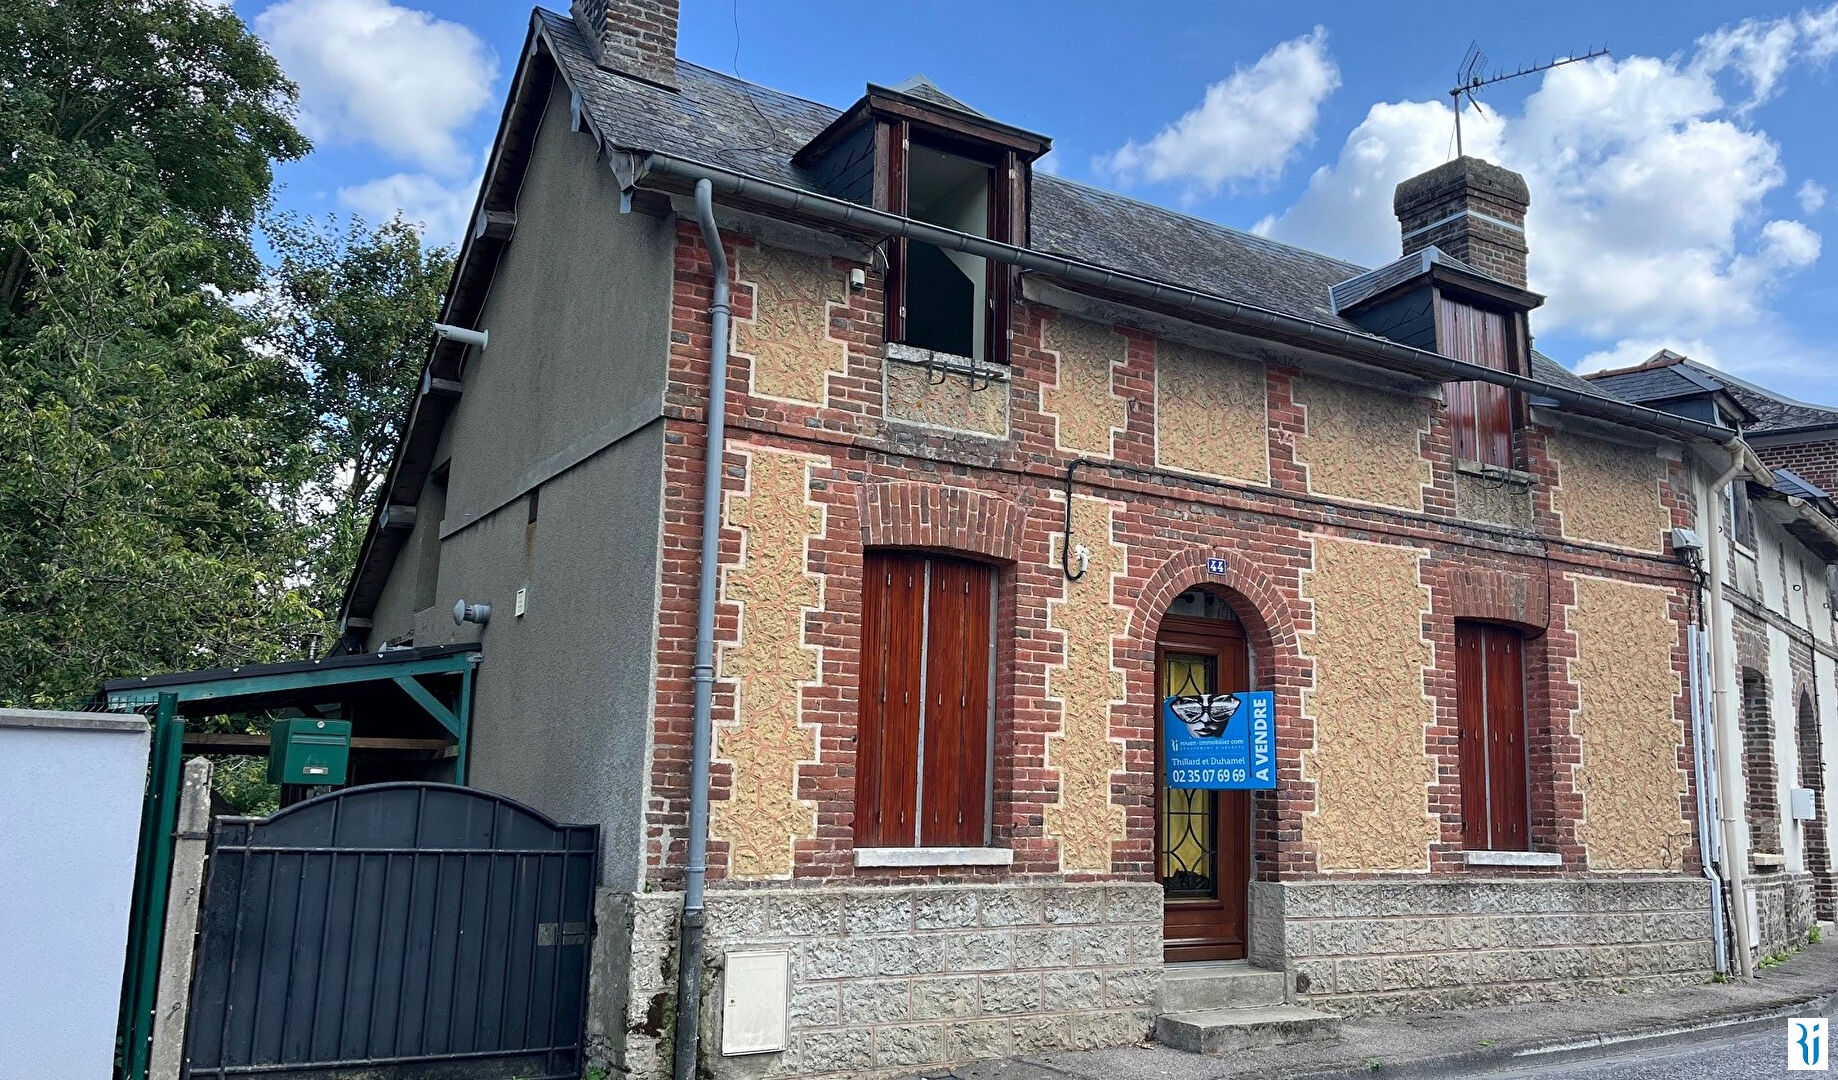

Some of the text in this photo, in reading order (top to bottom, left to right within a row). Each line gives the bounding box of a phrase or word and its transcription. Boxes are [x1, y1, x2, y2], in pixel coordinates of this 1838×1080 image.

[1210, 561, 1224, 573] 44
[1253, 699, 1269, 781] A VENDRE
[1171, 757, 1201, 766] Thillard
[1210, 757, 1246, 765] Duhamel
[1173, 768, 1246, 783] 02 35 07 69 69
